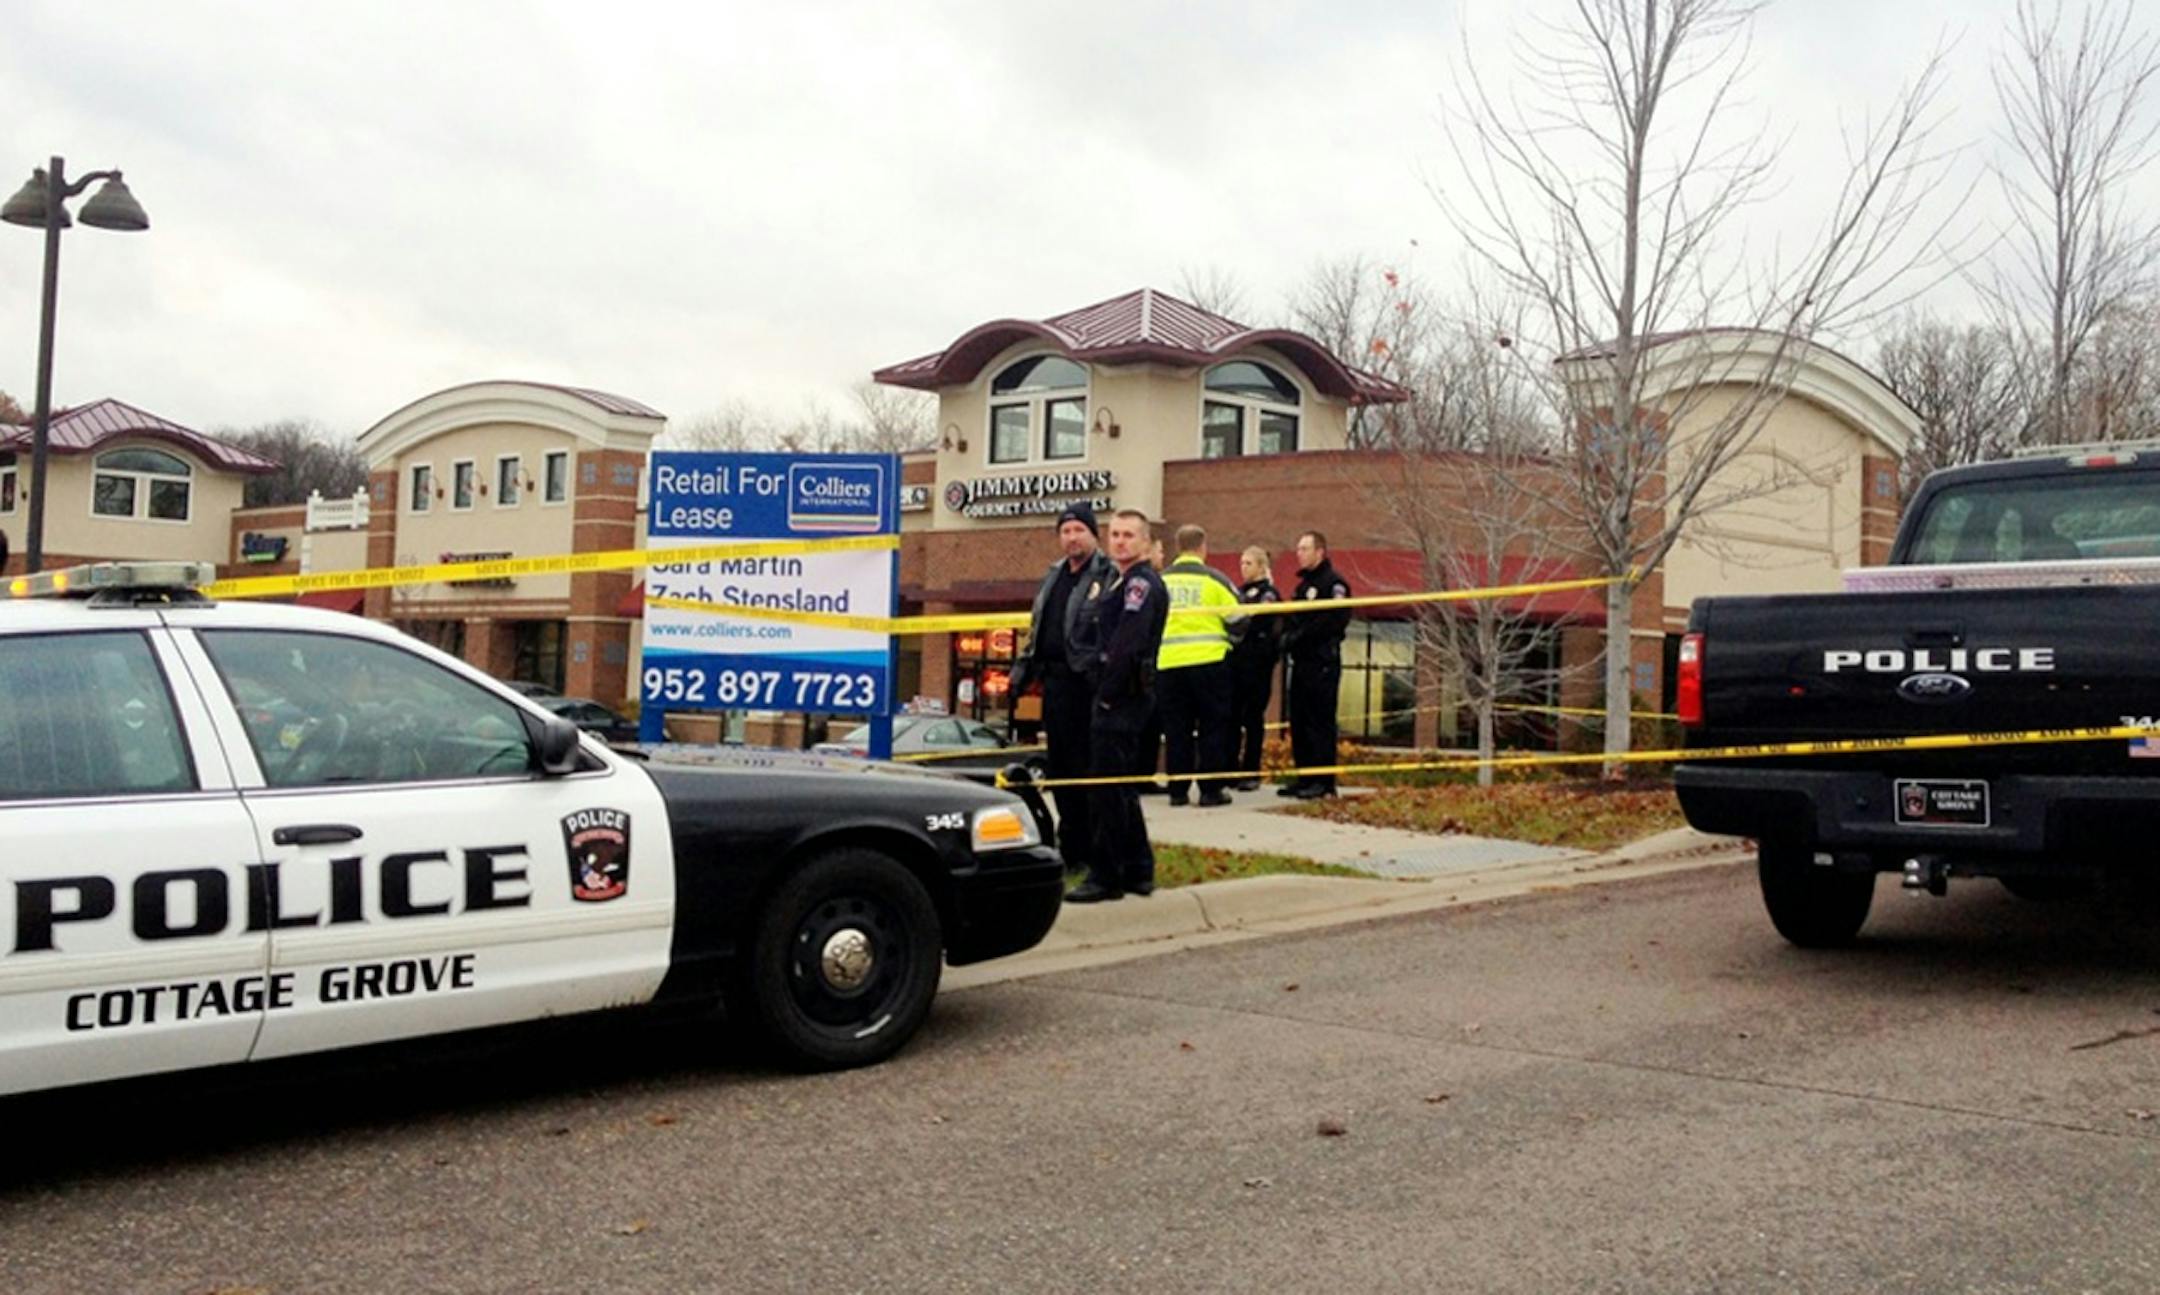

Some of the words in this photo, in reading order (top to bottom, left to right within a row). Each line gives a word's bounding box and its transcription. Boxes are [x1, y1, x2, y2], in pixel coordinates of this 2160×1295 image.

[656, 466, 730, 495] Retail
[738, 467, 785, 495] For
[800, 476, 871, 497] Colliers
[968, 475, 1034, 502] JIMMY
[655, 501, 733, 528] Lease
[800, 498, 870, 507] INTERNATIONAL
[721, 557, 803, 577] Martin
[723, 586, 849, 613] Stensland
[650, 622, 792, 639] www.colliers.com
[1824, 648, 2056, 672] POLICE
[644, 668, 706, 701] 952
[718, 670, 781, 704] 897
[793, 672, 875, 707] 7723
[566, 810, 625, 833] POLICE
[925, 811, 965, 832] 345
[7, 844, 533, 954] POLICE
[66, 972, 295, 1031] COTTAGE
[319, 954, 476, 1002] GROVE
